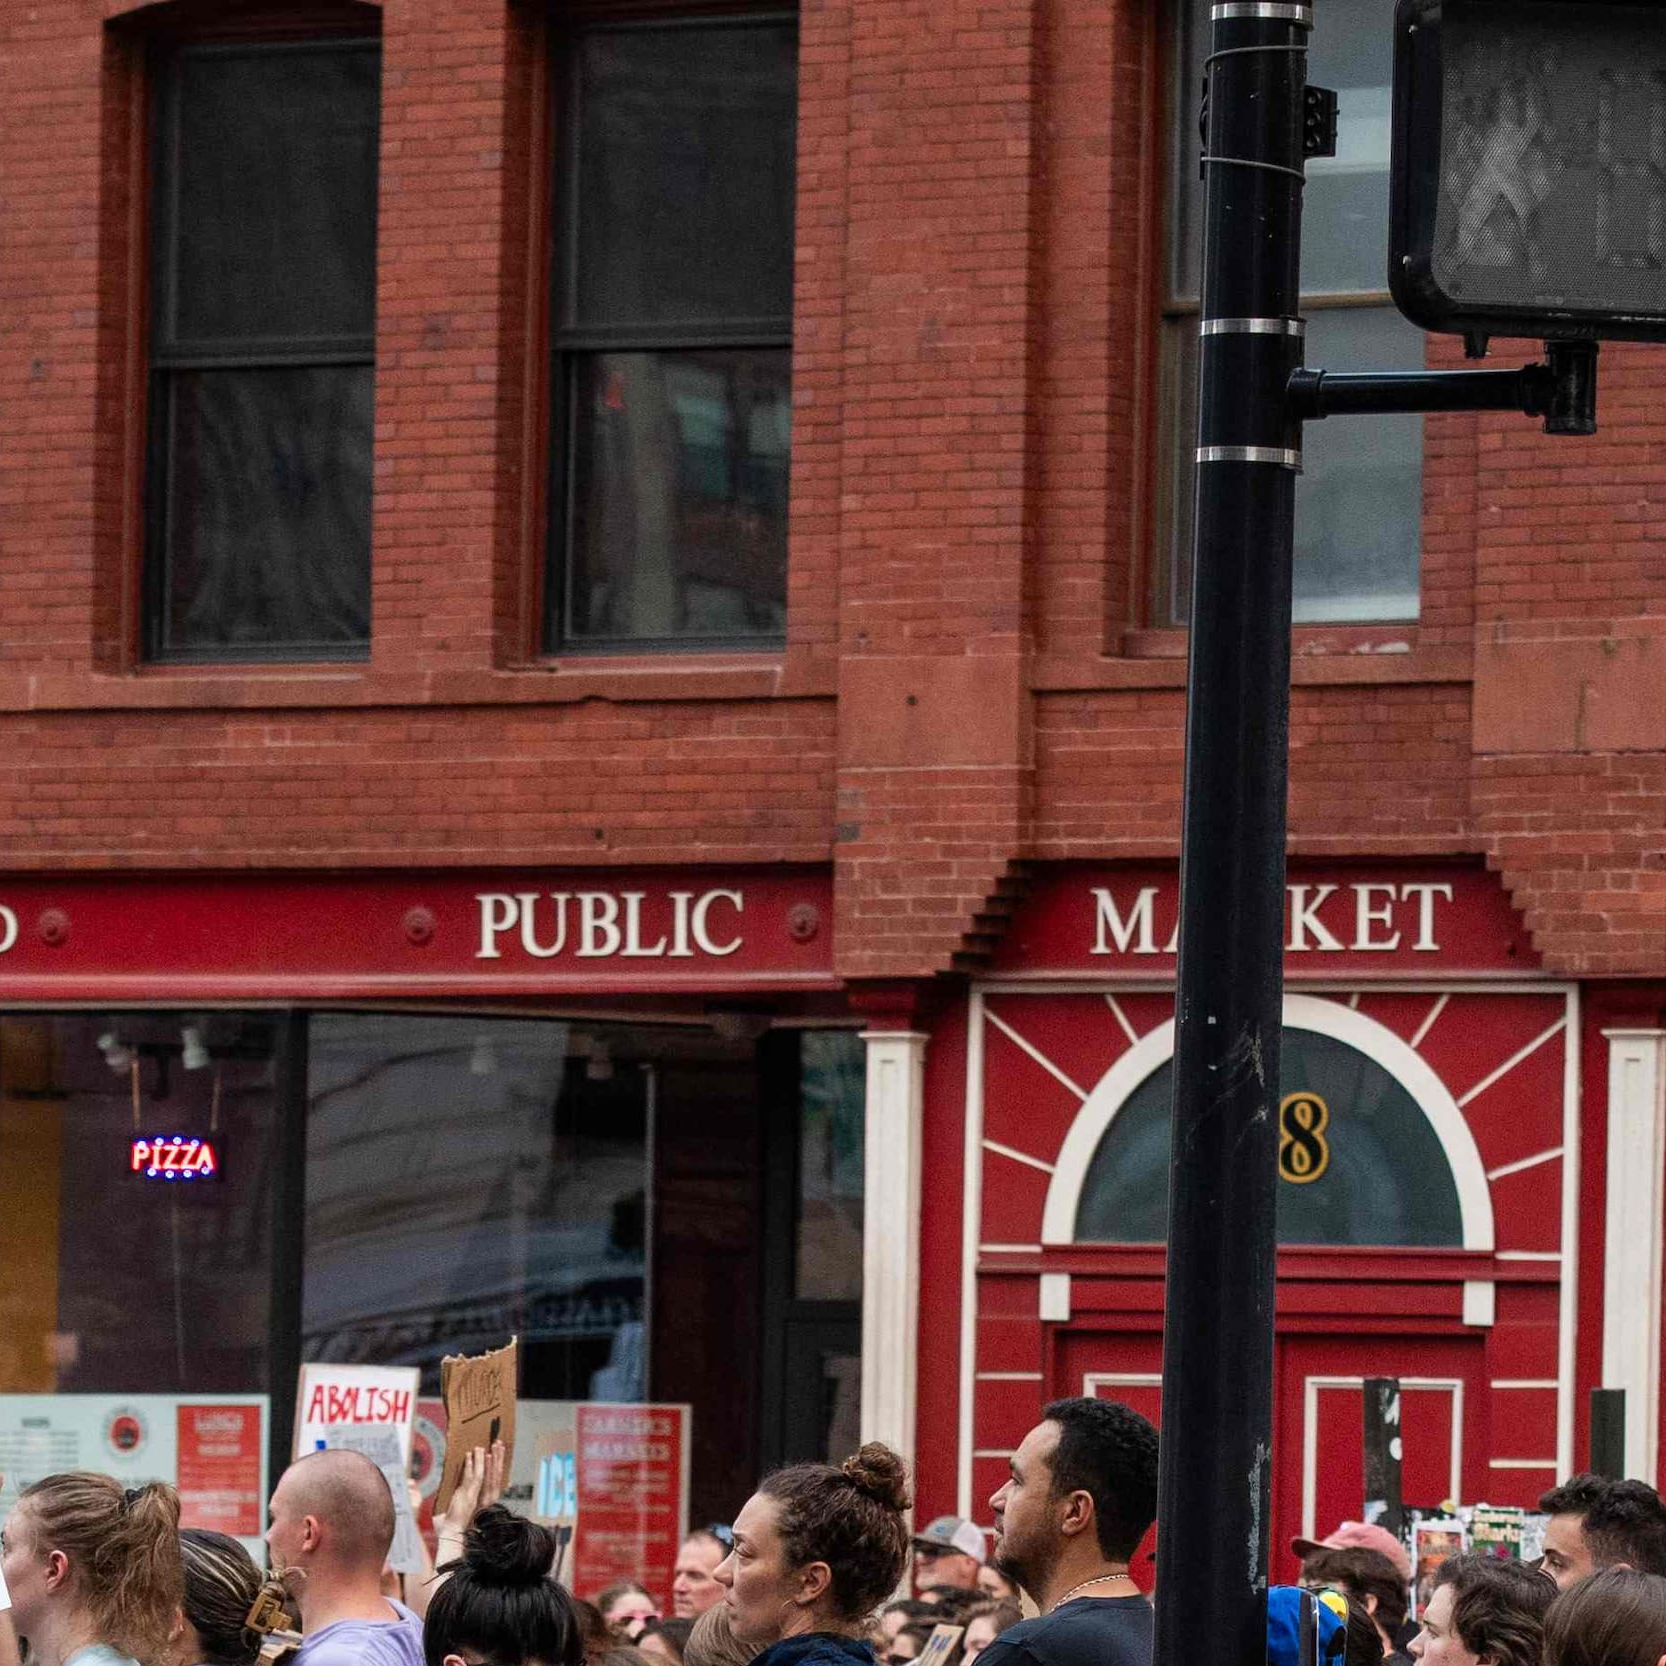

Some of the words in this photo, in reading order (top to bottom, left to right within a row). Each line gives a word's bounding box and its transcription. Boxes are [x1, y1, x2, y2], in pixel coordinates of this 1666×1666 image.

[474, 888, 744, 959] PUBLIC
[1089, 882, 1454, 955] MKET
[131, 1144, 217, 1172] PIZZA
[306, 1384, 411, 1424] ABOLISH
